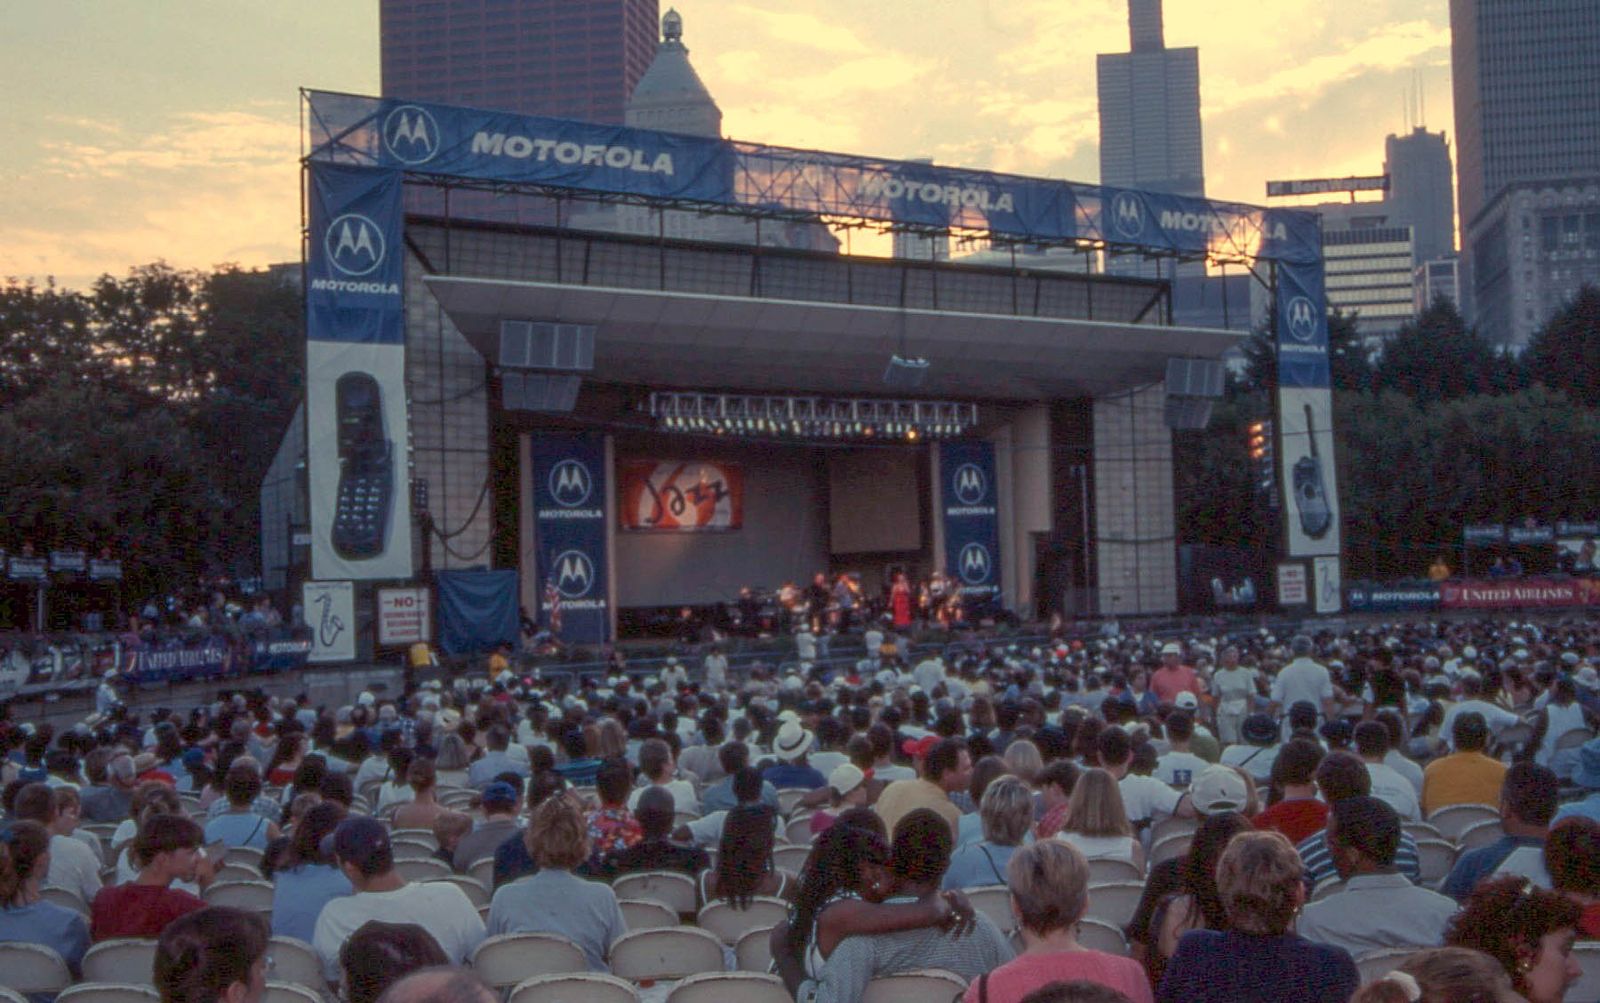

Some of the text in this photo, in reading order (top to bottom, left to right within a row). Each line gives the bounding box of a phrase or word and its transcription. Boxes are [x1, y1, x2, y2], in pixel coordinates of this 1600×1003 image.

[471, 131, 675, 176] MOTOROLA
[857, 174, 1015, 214] MOTOROLA
[311, 278, 399, 296] MOTOROLA
[640, 478, 730, 524] Jazz
[1371, 590, 1441, 601] MOTOROLA
[1462, 586, 1574, 601] UNITED AIRLINES
[393, 596, 415, 609] NO
[541, 600, 606, 611] MTOROLA
